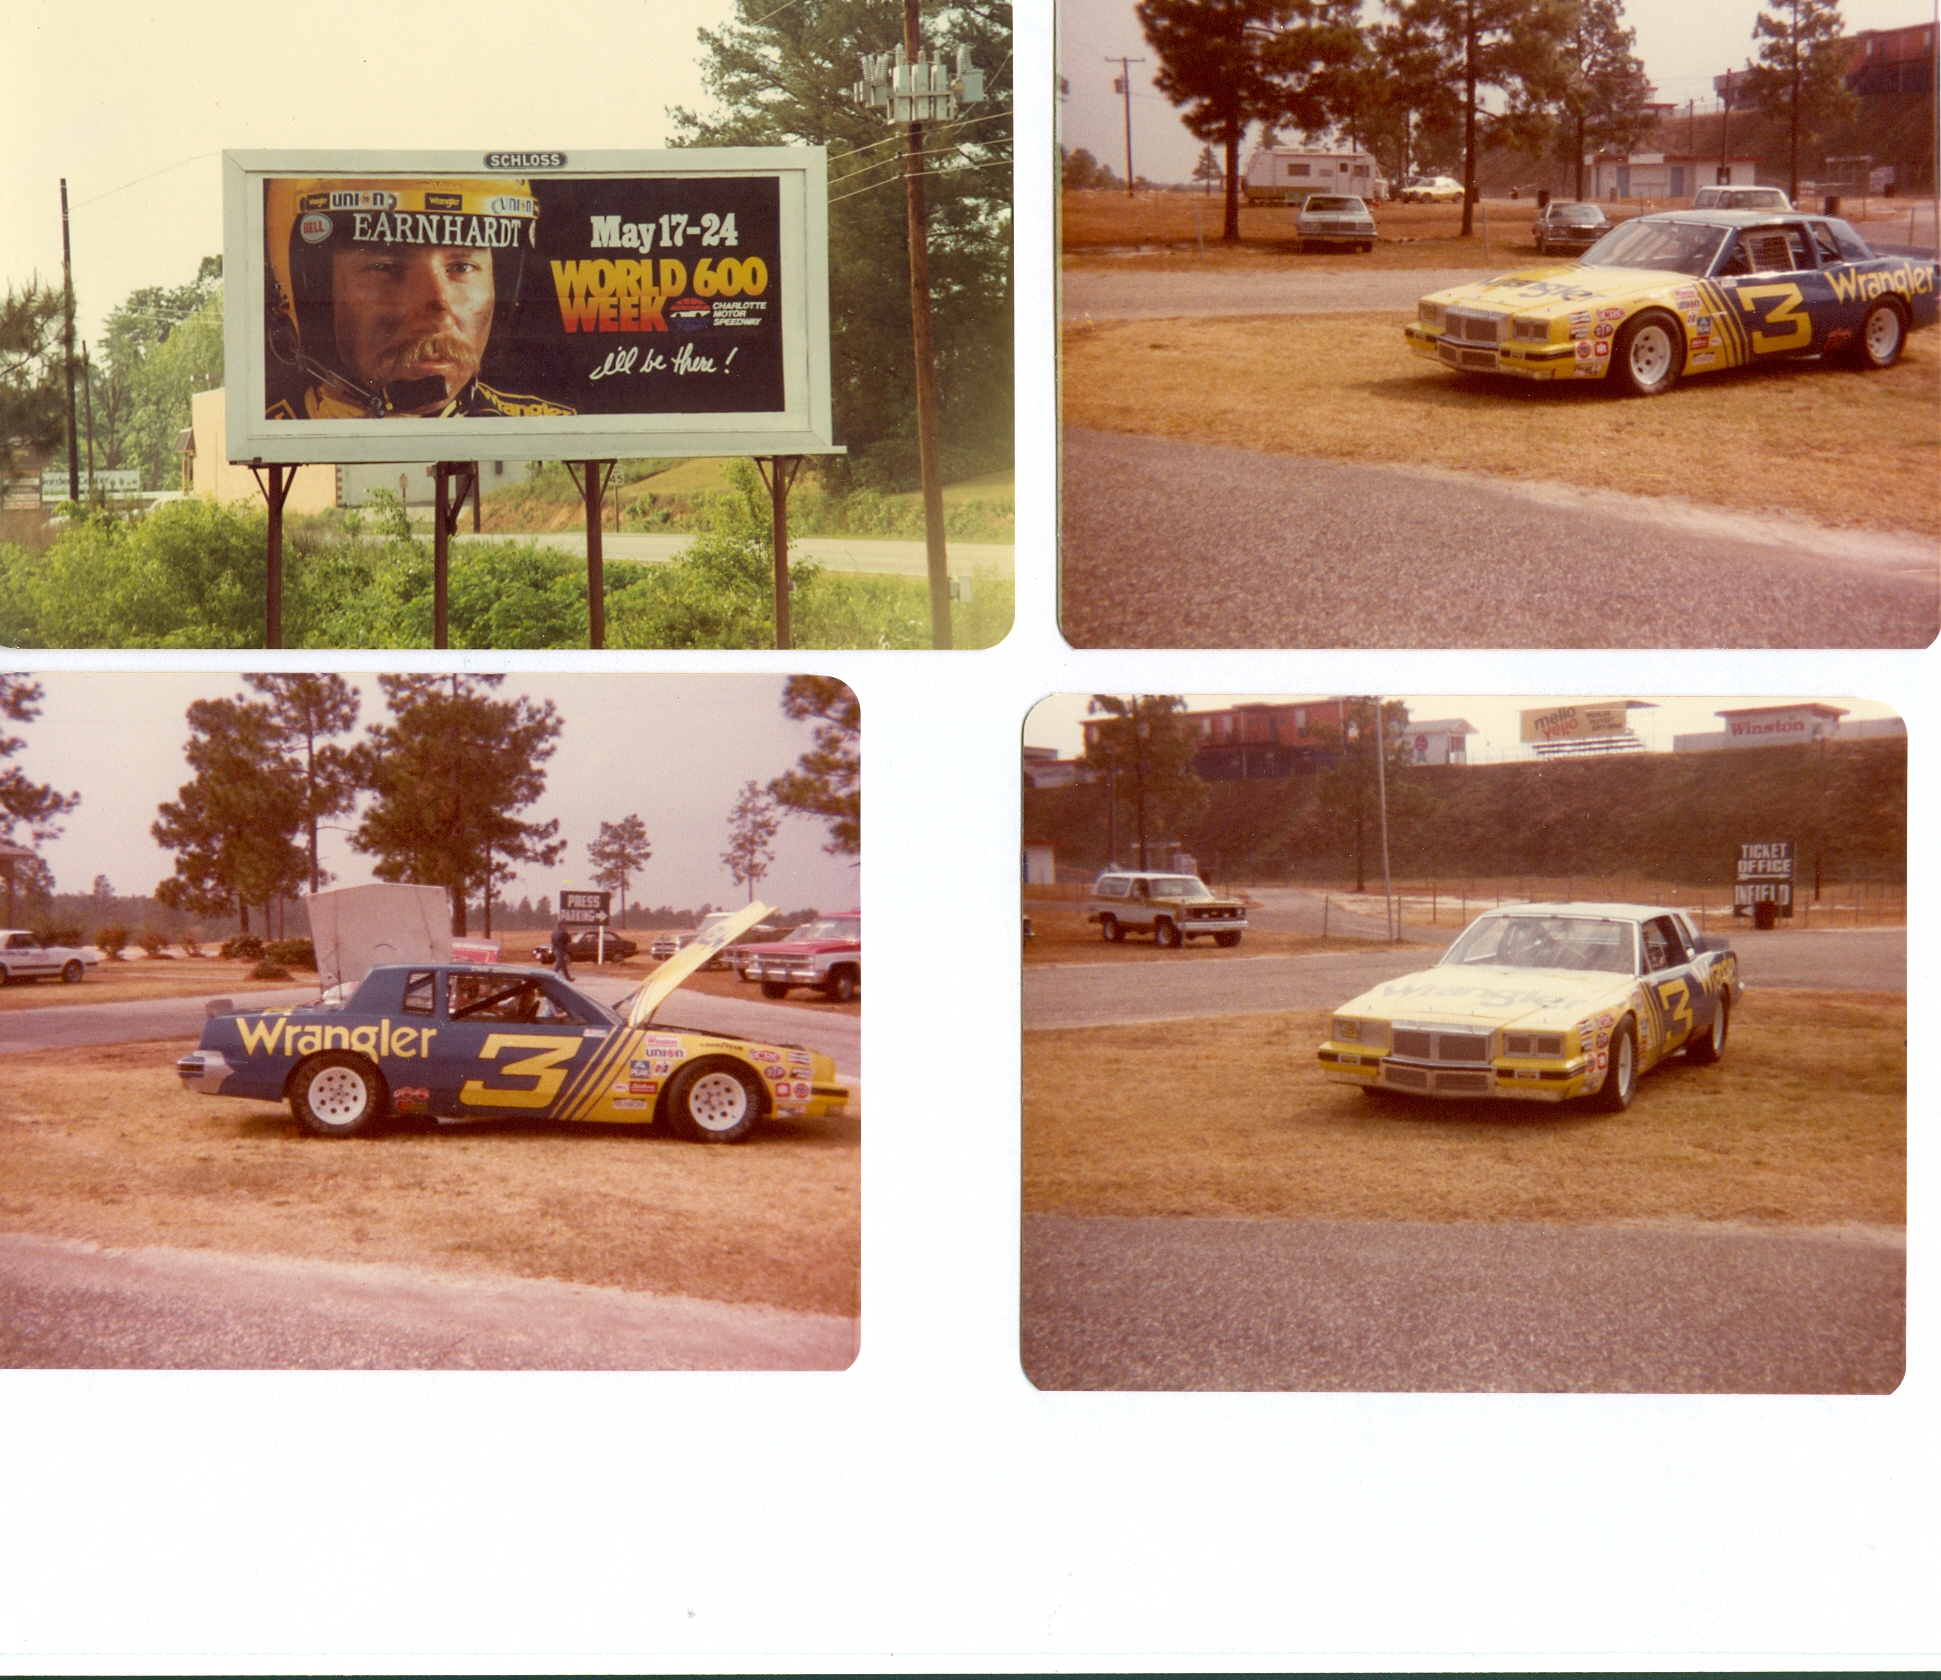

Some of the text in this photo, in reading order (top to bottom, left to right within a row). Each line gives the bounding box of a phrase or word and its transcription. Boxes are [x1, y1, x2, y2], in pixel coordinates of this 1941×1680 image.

[490, 153, 560, 167] SCHLOSS
[428, 196, 460, 209] Wrangler
[303, 220, 325, 235] BELL
[352, 212, 522, 247] EARNHARDT
[590, 213, 739, 254] May 17-24
[550, 256, 769, 298] WORLD 600
[1823, 261, 1935, 305] Wrangler
[712, 301, 768, 310] CHARLOTTE
[558, 295, 669, 333] WEEK
[713, 310, 747, 318] MOTOR
[713, 318, 763, 326] SPEEDWAY
[1736, 282, 1812, 355] 3
[1595, 324, 1612, 337] STP
[639, 348, 667, 373] be
[610, 474, 623, 484] 45
[1534, 706, 1576, 731] mello
[1730, 720, 1805, 736] Winston
[1741, 843, 1788, 859] TICKET
[1737, 859, 1792, 873] OFFICE
[567, 894, 601, 908] PRESS
[1658, 977, 1694, 1053] 3
[235, 1017, 437, 1065] Wrangler
[459, 1033, 583, 1109] 3
